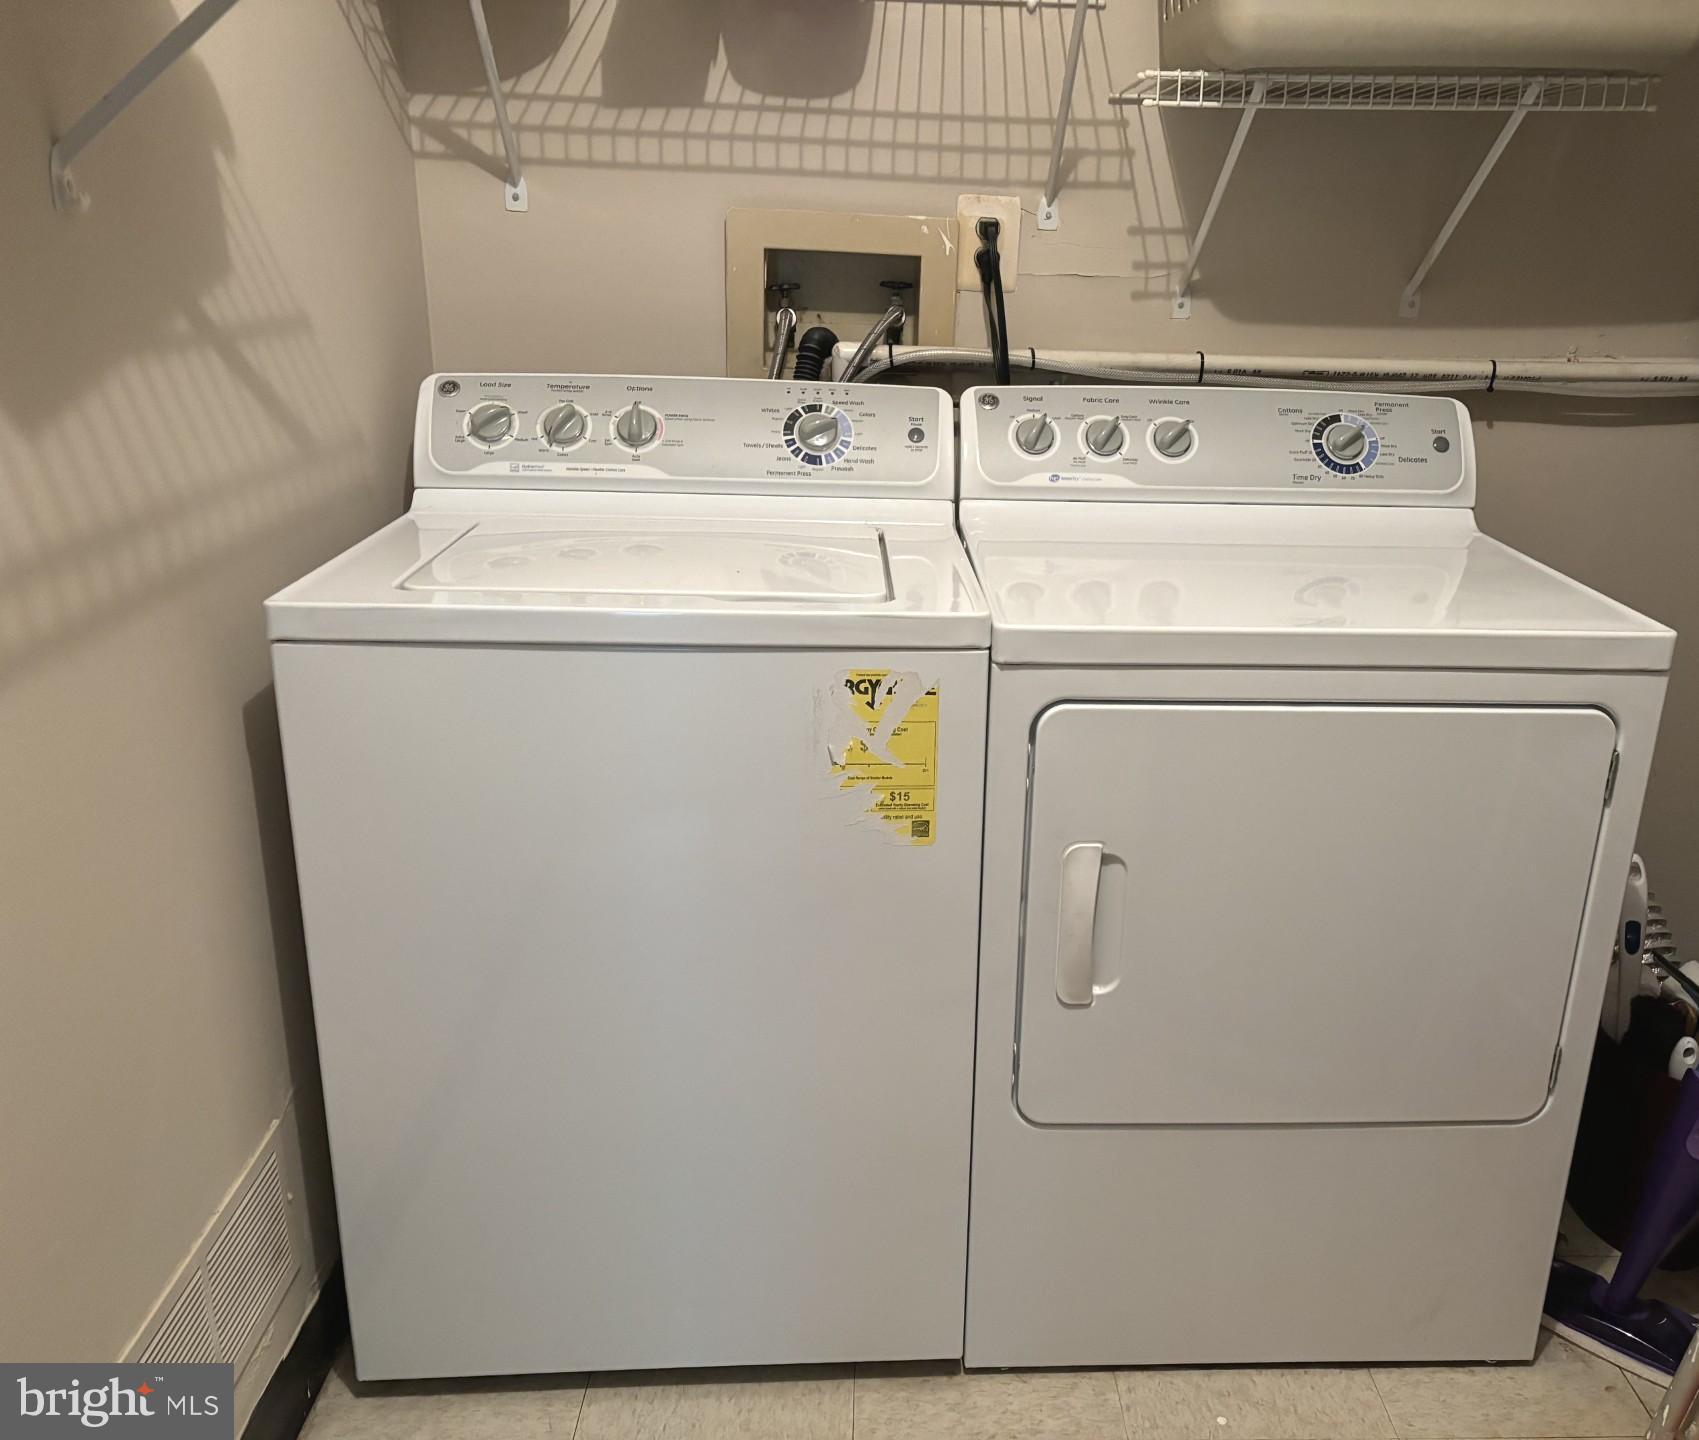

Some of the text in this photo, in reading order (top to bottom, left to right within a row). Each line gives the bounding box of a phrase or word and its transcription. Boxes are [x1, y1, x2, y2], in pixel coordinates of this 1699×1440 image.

[546, 383, 590, 391] Temperature
[626, 385, 653, 393] Options
[1023, 395, 1044, 403] Signal
[1398, 456, 1428, 464] Delicates
[1292, 473, 1322, 482] Time Dry
[890, 791, 910, 802] $15
